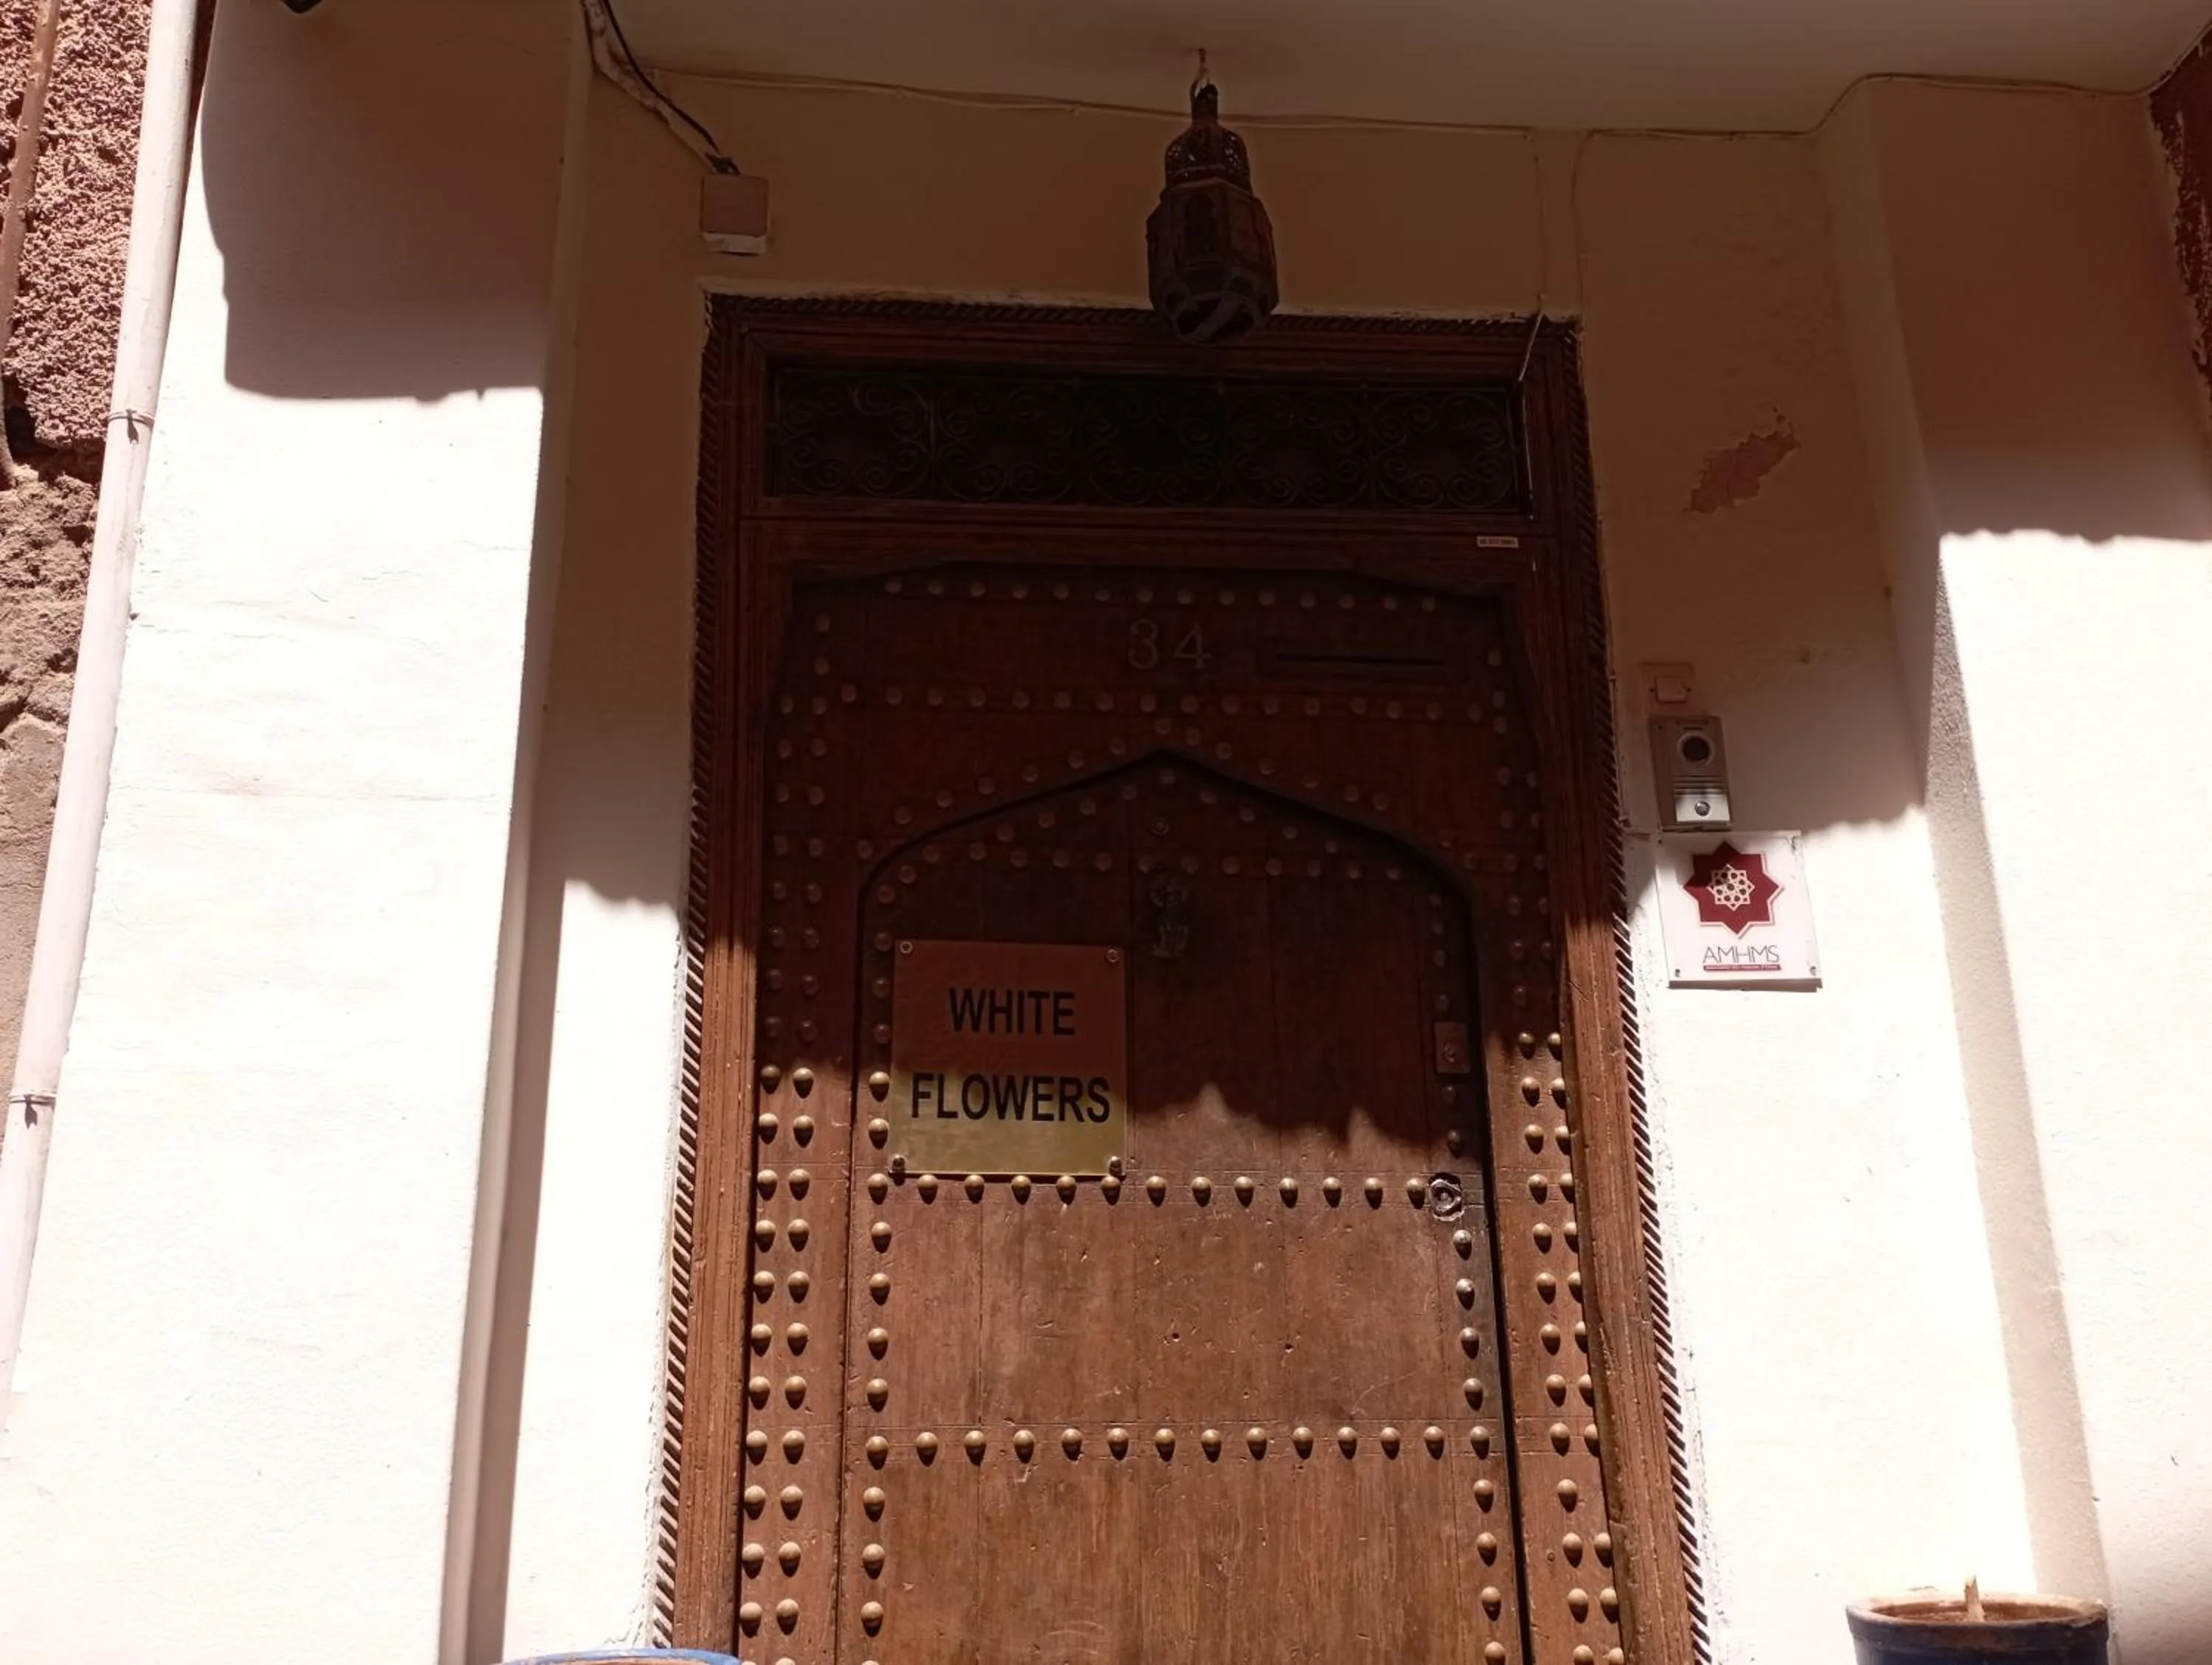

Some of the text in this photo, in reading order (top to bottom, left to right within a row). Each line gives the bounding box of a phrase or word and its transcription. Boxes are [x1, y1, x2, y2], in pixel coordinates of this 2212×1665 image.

[1127, 619, 1211, 670] 34
[1703, 945, 1780, 963] AMHMS
[949, 988, 1076, 1036] WHITE
[911, 1073, 1110, 1123] FLOWERS
